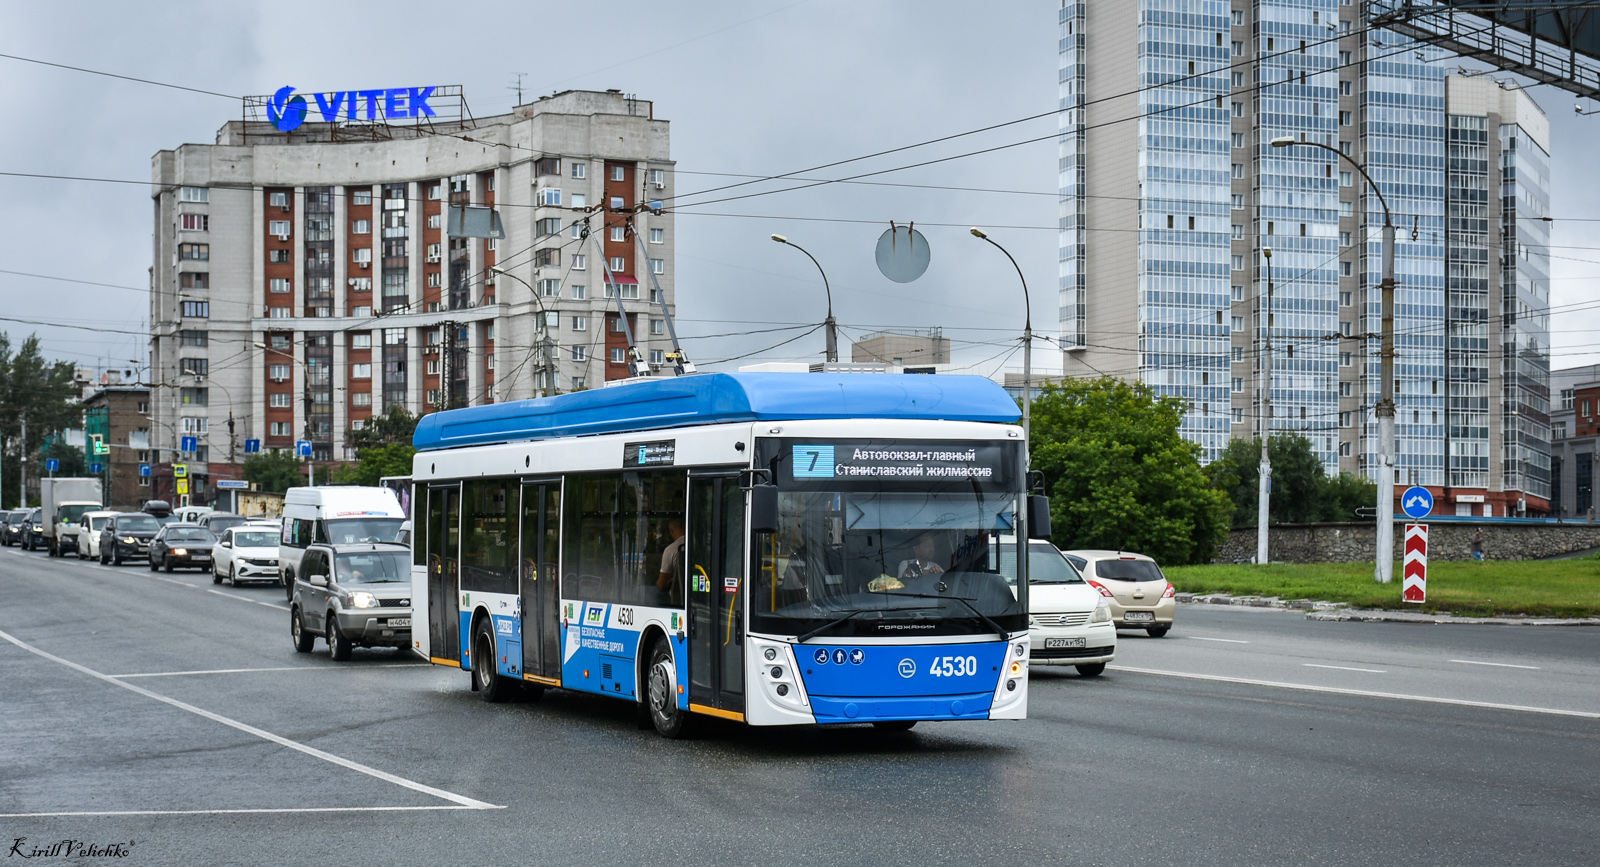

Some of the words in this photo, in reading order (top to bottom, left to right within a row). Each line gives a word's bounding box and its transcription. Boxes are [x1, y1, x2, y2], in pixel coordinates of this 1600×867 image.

[314, 86, 437, 122] VITEK
[806, 451, 820, 472] 7
[852, 448, 976, 462] Автовокзал-главный
[835, 463, 923, 477] Станиславский
[926, 465, 992, 477] жилмассив
[617, 607, 634, 626] 4530
[581, 627, 606, 639] БЕЗОПАСНЫЕ
[581, 639, 609, 651] КАЧЕСТВЕННЫЕ
[609, 641, 624, 653] ДОРОГИ
[929, 655, 978, 677] 4530
